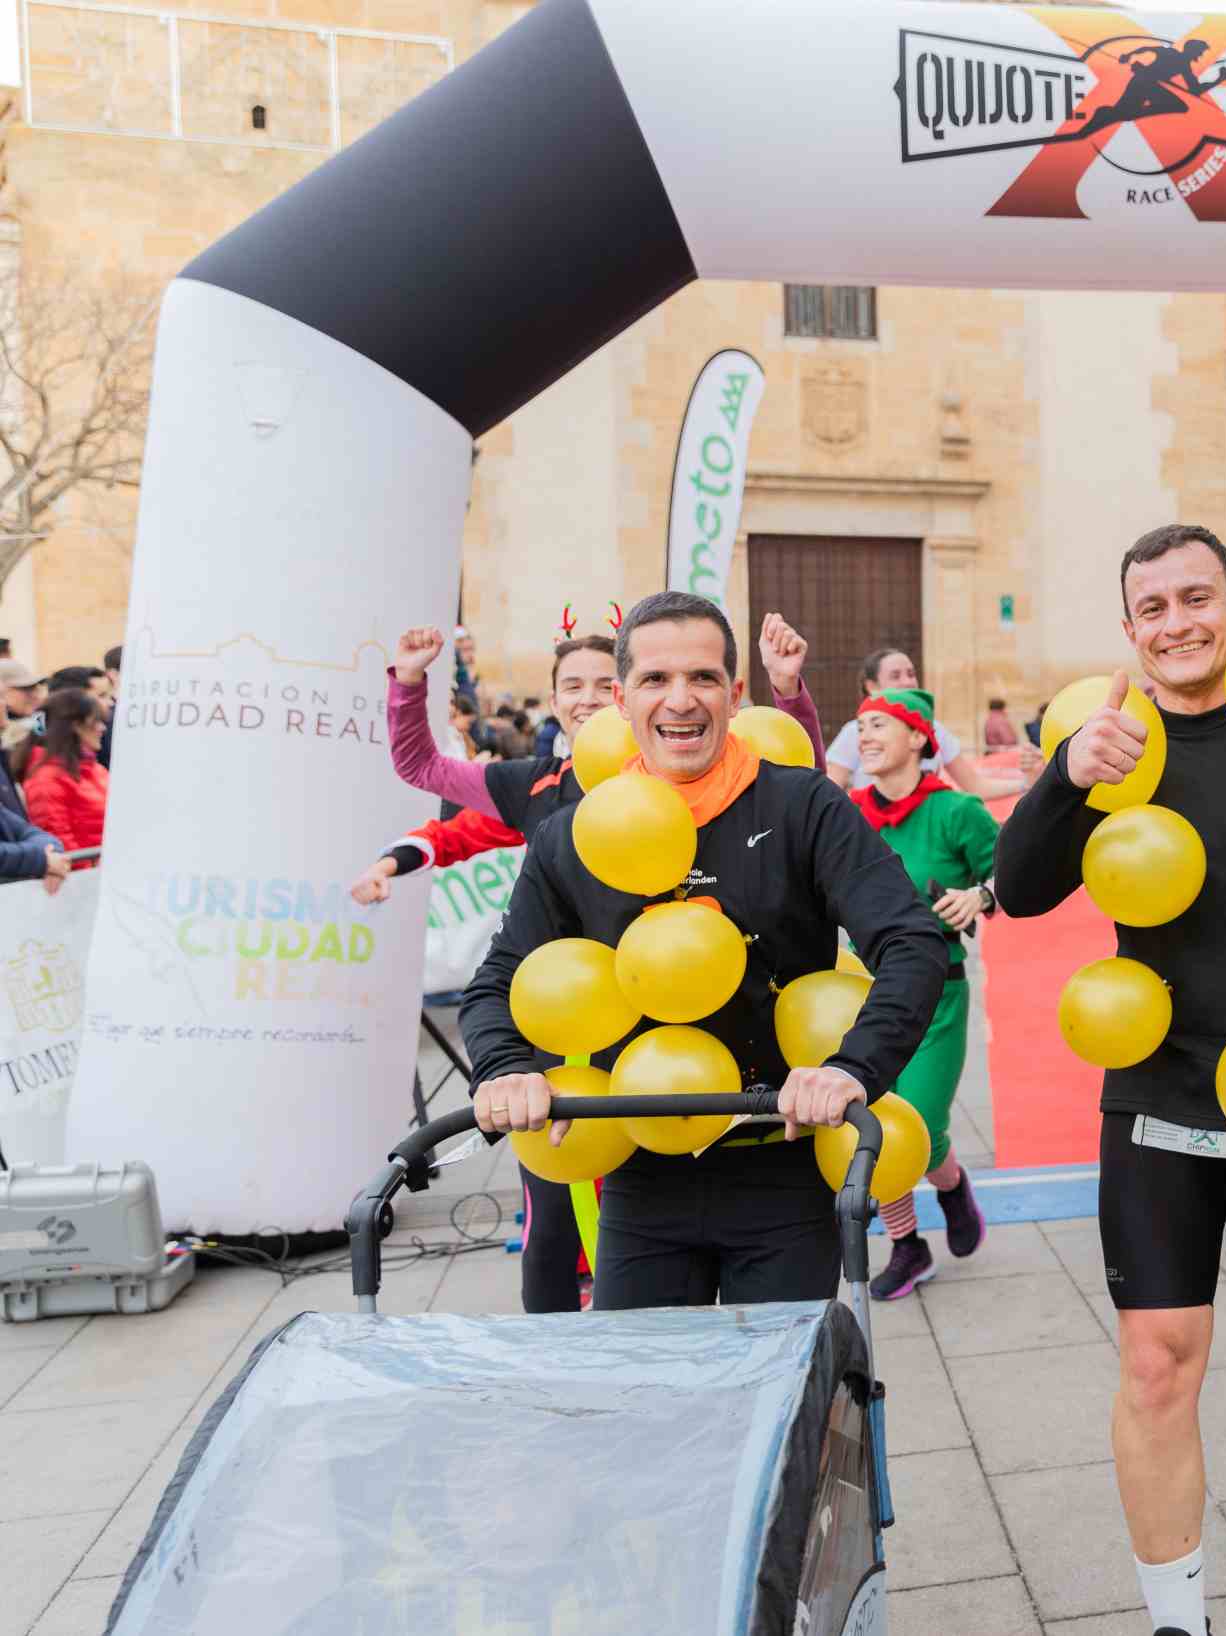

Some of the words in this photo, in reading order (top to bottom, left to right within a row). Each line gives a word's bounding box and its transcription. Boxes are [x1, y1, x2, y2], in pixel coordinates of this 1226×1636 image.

[916, 52, 1087, 140] QUIJOTE
[1126, 187, 1174, 206] RACE
[126, 702, 265, 729] CIUDAD
[285, 708, 384, 745] REAL
[177, 914, 376, 965] CIUDAD
